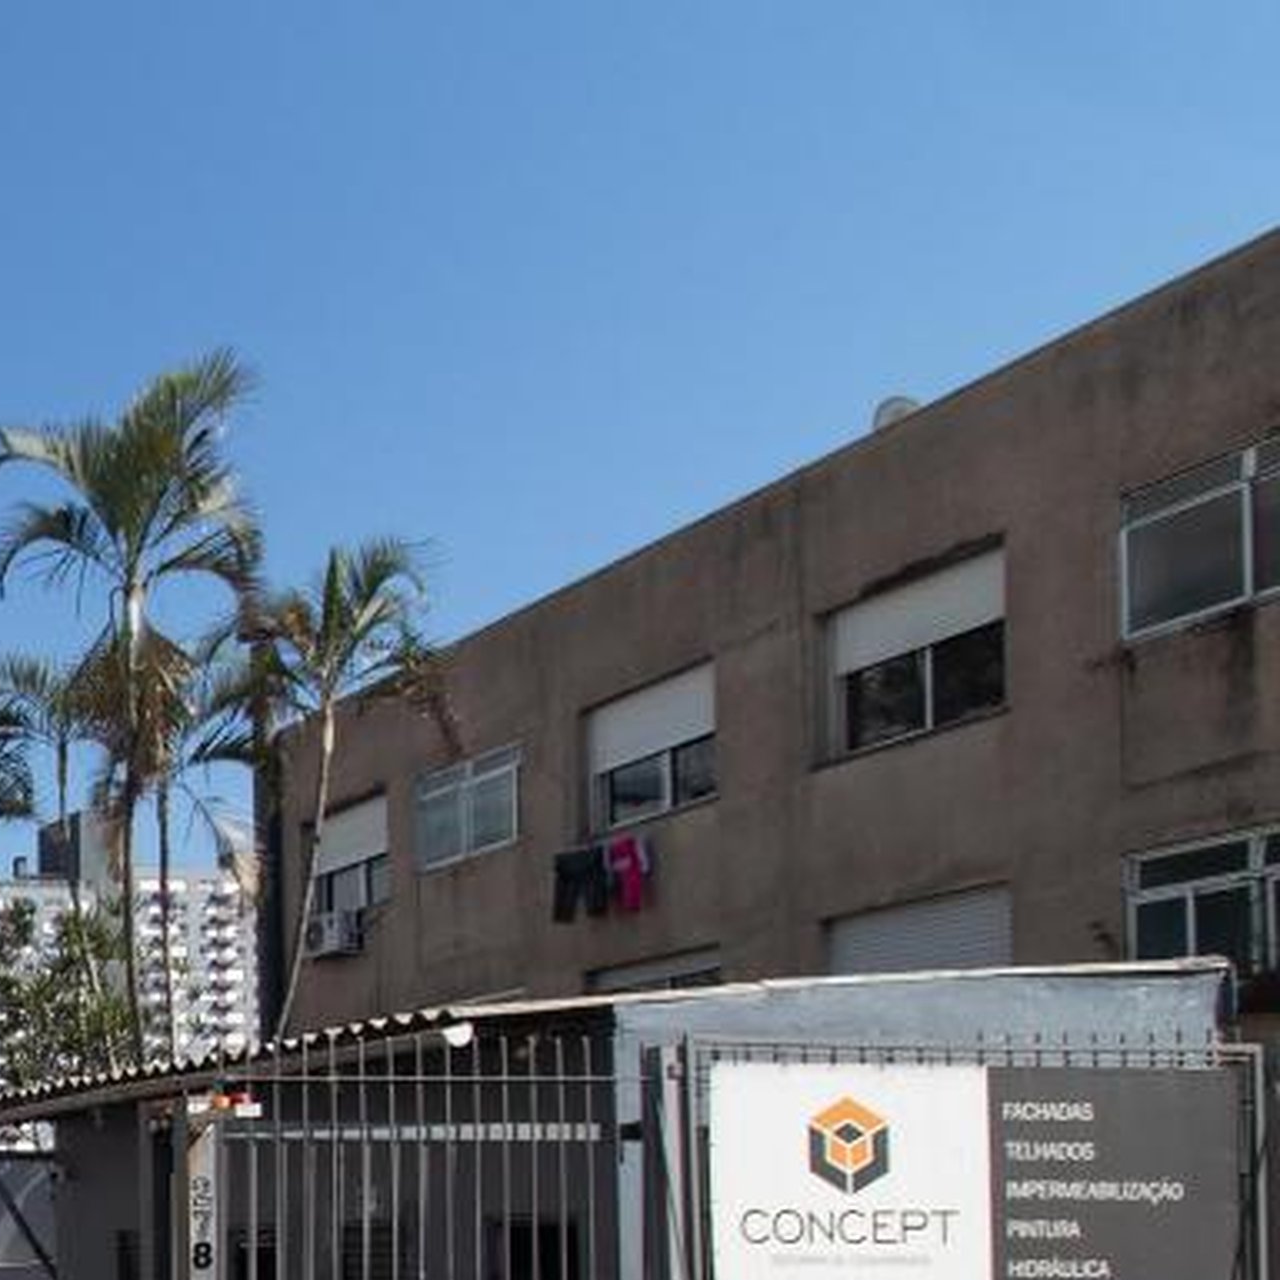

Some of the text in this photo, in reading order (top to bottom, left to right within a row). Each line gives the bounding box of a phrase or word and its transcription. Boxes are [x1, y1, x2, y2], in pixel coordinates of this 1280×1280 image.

[1002, 1102, 1094, 1121] FACHADAS
[1005, 1142, 1095, 1161] TELHADOS
[1006, 1176, 1185, 1205] IMPERMEABILIZAÇÃO
[741, 1208, 960, 1245] CONCEPT
[1006, 1219, 1082, 1238] PINTURA
[1007, 1257, 1112, 1279] HIDRÁULICA
